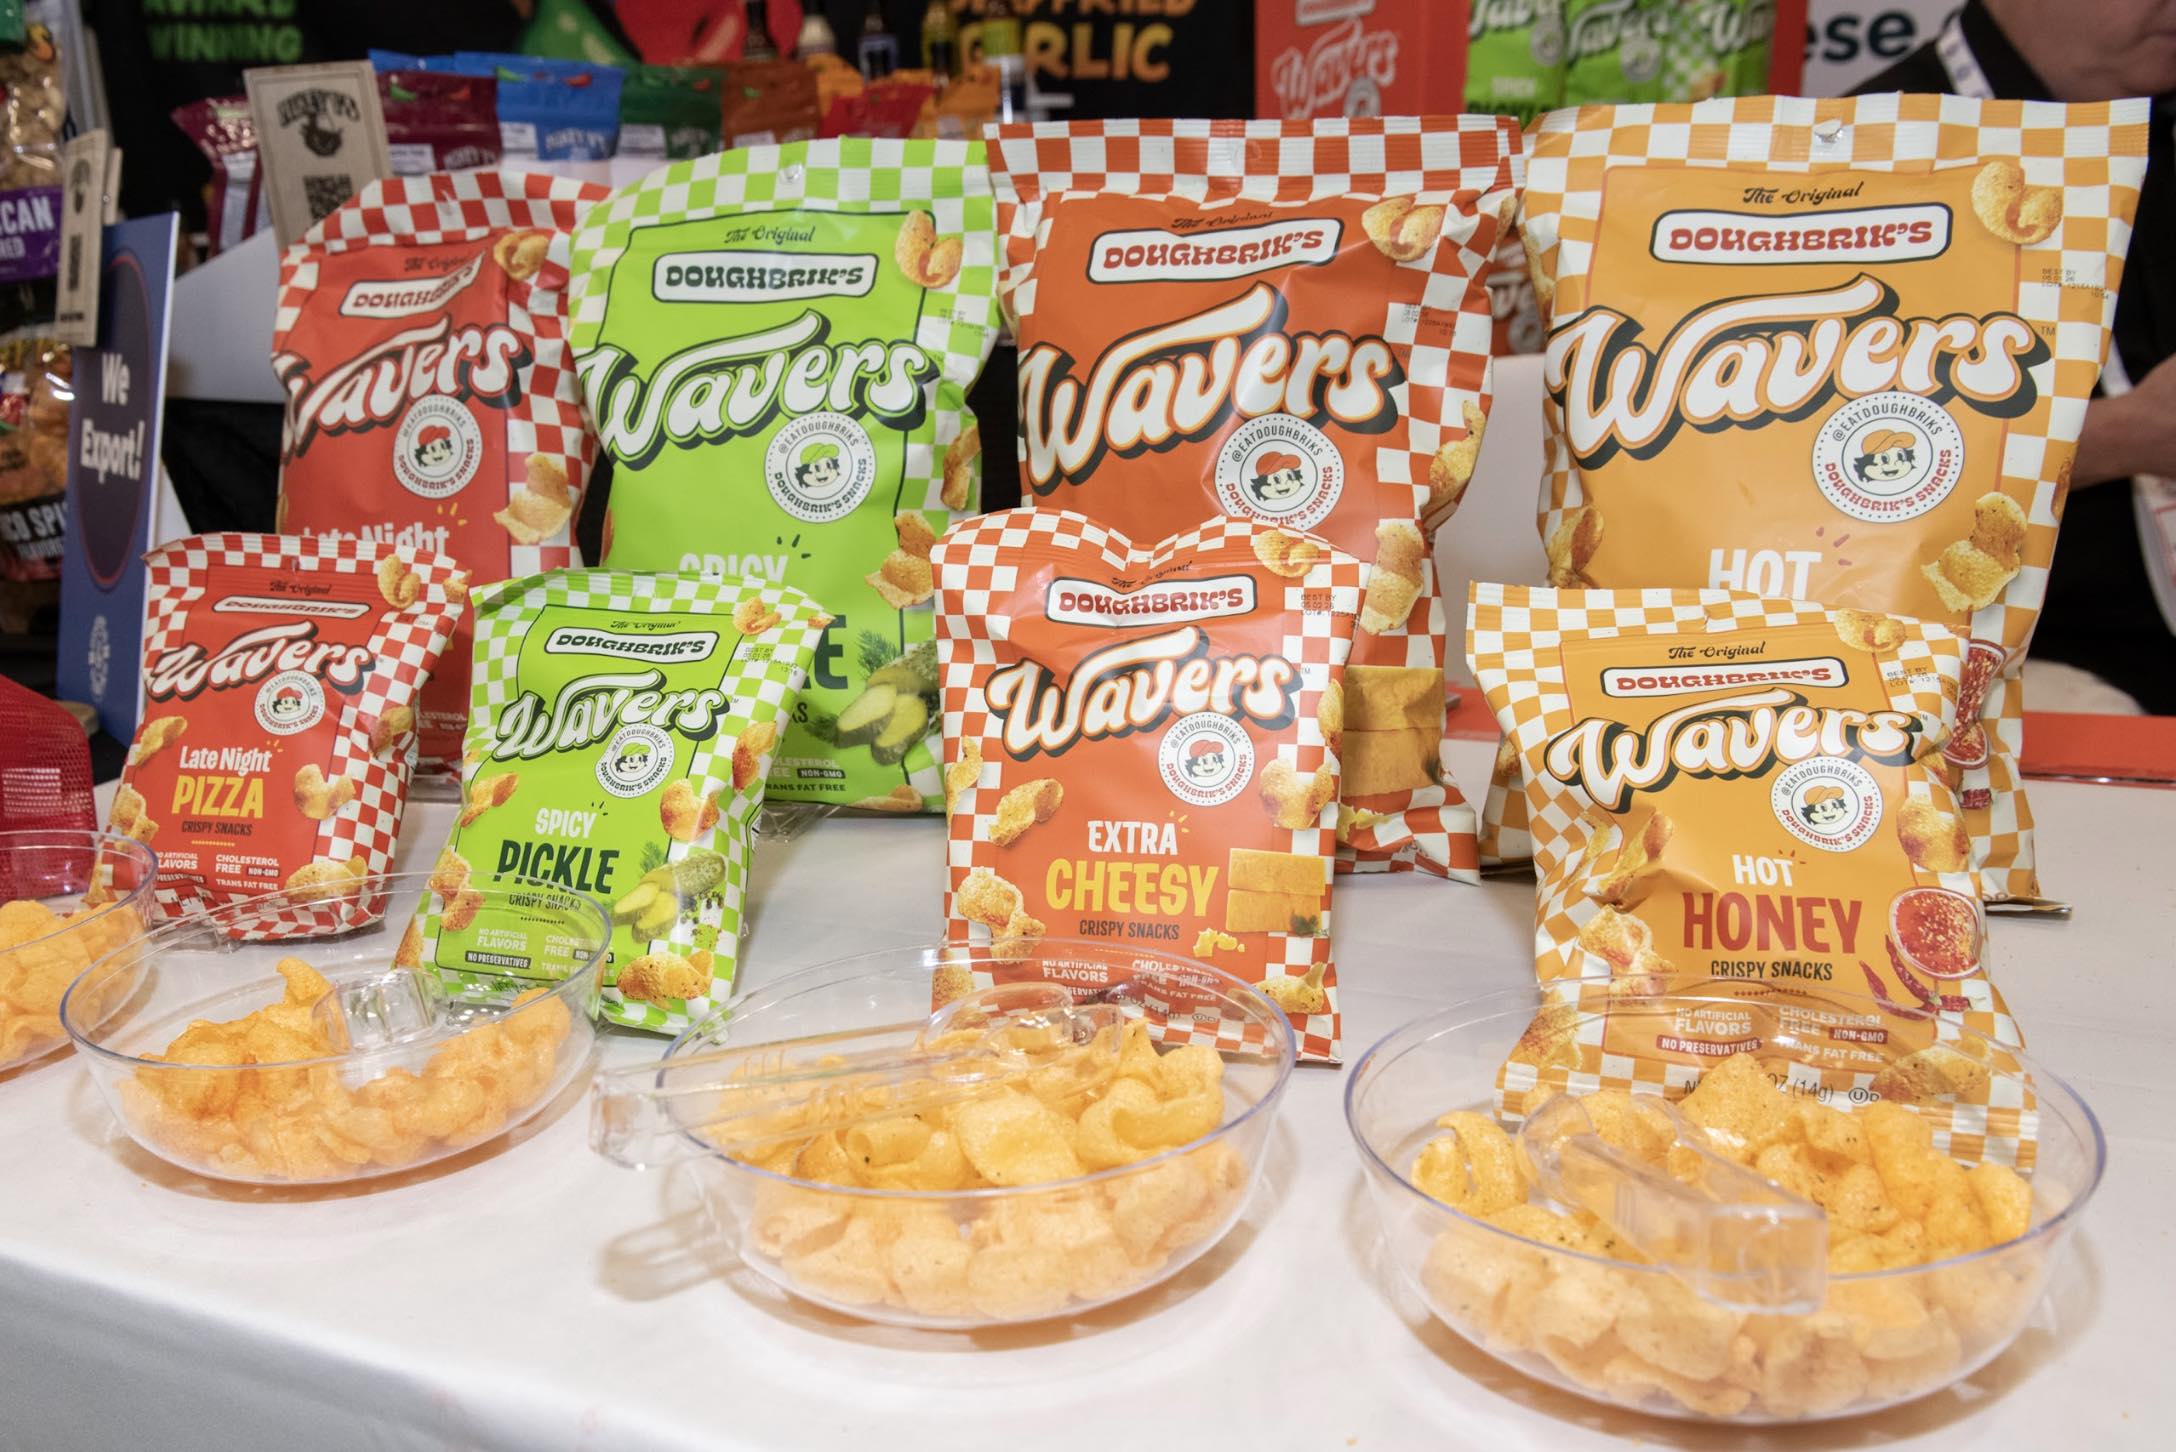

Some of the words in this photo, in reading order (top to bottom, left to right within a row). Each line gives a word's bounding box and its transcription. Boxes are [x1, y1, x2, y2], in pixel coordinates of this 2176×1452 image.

[960, 22, 1173, 82] GRLIC
[1743, 186, 1779, 204] The
[1781, 182, 1864, 205] Original
[0, 196, 54, 236] CAN
[724, 227, 749, 244] The
[754, 224, 816, 246] Original
[1103, 231, 1324, 269] DOUGHBRIK'S
[1669, 221, 1933, 252] DOUGHBRIK'S
[665, 264, 864, 291] DOUGHBRIK'S
[102, 352, 130, 405] We
[1546, 273, 2043, 463] Wavers
[574, 309, 930, 464] Wavers
[1019, 283, 1400, 490] Wavers
[778, 421, 859, 454] @EATDOUGHBRIKS
[1832, 403, 1942, 441] @EATDOUGHBRIKS
[80, 418, 145, 483] Export!
[455, 438, 474, 480] SNACKS
[1232, 425, 1323, 462] @EATDOUGHBRIKS
[775, 472, 842, 513] DOUGHBRIK'S
[842, 458, 867, 503] SNACKS
[1306, 466, 1333, 514] SNACKS
[1825, 463, 1915, 511] DOUGHBRIK'S
[1915, 449, 1952, 502] SNACKS
[1708, 548, 1822, 599] HOT
[1059, 588, 1244, 615] DOUGHBRIK'S
[610, 620, 629, 629] The
[149, 621, 374, 699] Wavers
[556, 635, 706, 656] DOUGHBRIK'S
[1668, 645, 1695, 661] The
[1698, 640, 1766, 660] Original
[986, 627, 1299, 757] Wavers
[1616, 667, 1832, 690] DOUGHBRIK'S
[493, 668, 727, 757] Wavers
[1170, 721, 1240, 749] @EATDOUGHBRIKS
[1548, 688, 1916, 809] Wavers
[179, 745, 218, 770] Late
[219, 747, 273, 777] Night
[601, 762, 643, 792] DOUGHBRIK'S
[643, 757, 667, 786] SNACKS
[801, 769, 843, 778] NON-GMO
[1167, 763, 1226, 798] DOUGHBRIK'S
[1225, 754, 1247, 791] SNACKS
[766, 783, 794, 791] RANS
[1781, 765, 1862, 796] @EATDOUGHBRIKS
[171, 775, 264, 819] PIZZA
[181, 821, 213, 834] CRISPY
[215, 822, 253, 836] SNACKS
[535, 808, 597, 839] SPICY
[1782, 809, 1852, 846] DOUGHBRIK'S
[1851, 795, 1874, 838] SNACKS
[1087, 820, 1178, 856] EXTRA
[158, 859, 198, 870] LAVORS
[164, 852, 198, 860] ARTIFICIAL
[216, 854, 280, 867] CHOLESTEROL
[216, 864, 241, 874] FREE
[248, 867, 279, 878] NON-GMO
[492, 840, 620, 895] PICKLE
[1732, 854, 1794, 887] HOT
[216, 879, 241, 888] TRANS
[243, 881, 257, 889] FAT
[259, 883, 279, 891] FREE
[1045, 857, 1219, 918] CHEESY
[1079, 919, 1125, 937] CRISPY
[1128, 922, 1180, 941] SNACKS
[1681, 892, 1862, 955] HONEY
[476, 936, 527, 951] FLAVORS
[544, 945, 570, 957] FREE
[467, 953, 478, 962] NO
[478, 955, 529, 967] PRESERVATIVES
[1043, 968, 1109, 983] FLAVORS
[1710, 960, 1766, 979] CRISPY
[1771, 960, 1833, 982] SNACKS
[1674, 1017, 1752, 1036] FLAVORS
[1676, 1007, 1691, 1017] NO
[1693, 1009, 1752, 1021] ARTIFICIAL
[1779, 1005, 1883, 1027] CHOLESTEROL
[1779, 1017, 1821, 1036] FREE
[1833, 1029, 1885, 1043] NON-GMO
[1661, 1037, 1677, 1050] NO
[1678, 1038, 1758, 1055] PRESERVATIVES
[1823, 1047, 1847, 1060] FAT
[1850, 1050, 1884, 1063] FREE
[1791, 1078, 1834, 1102] (14g)
